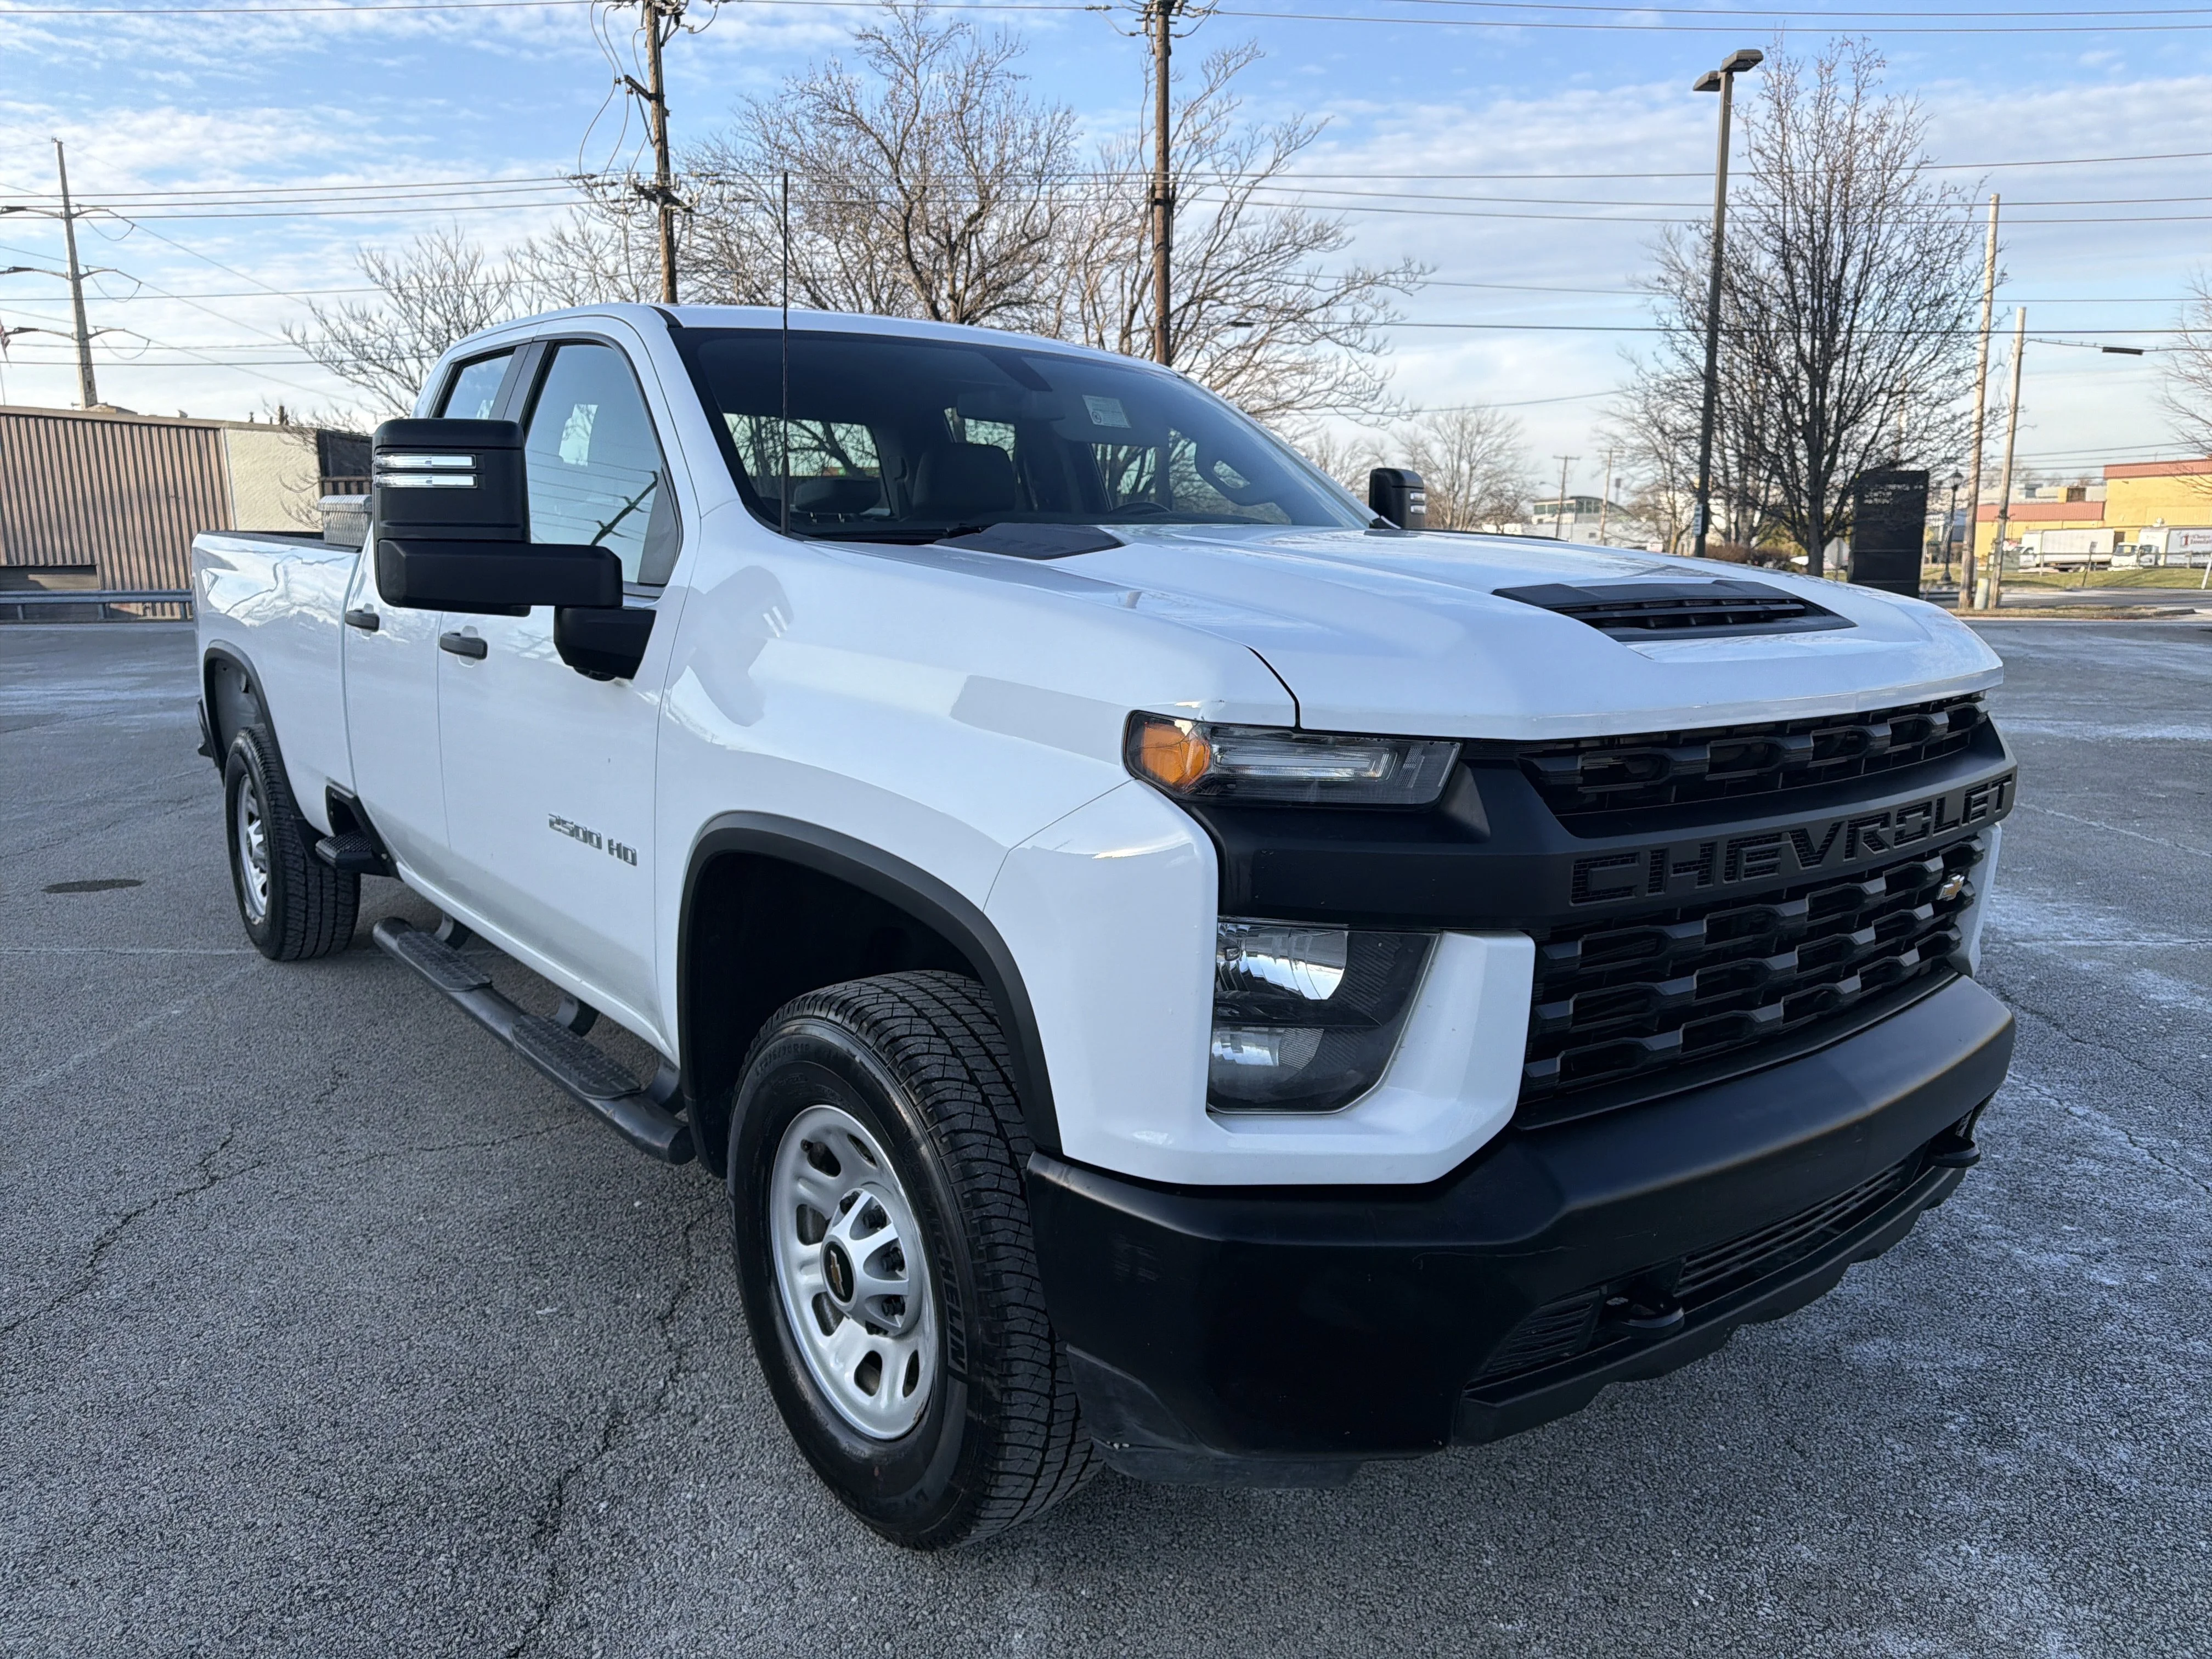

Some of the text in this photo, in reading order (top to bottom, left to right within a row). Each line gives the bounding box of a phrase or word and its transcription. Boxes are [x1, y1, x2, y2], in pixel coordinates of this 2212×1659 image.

[548, 812, 637, 867] 2500 HD
[1570, 775, 2012, 906] CHEVROLET
